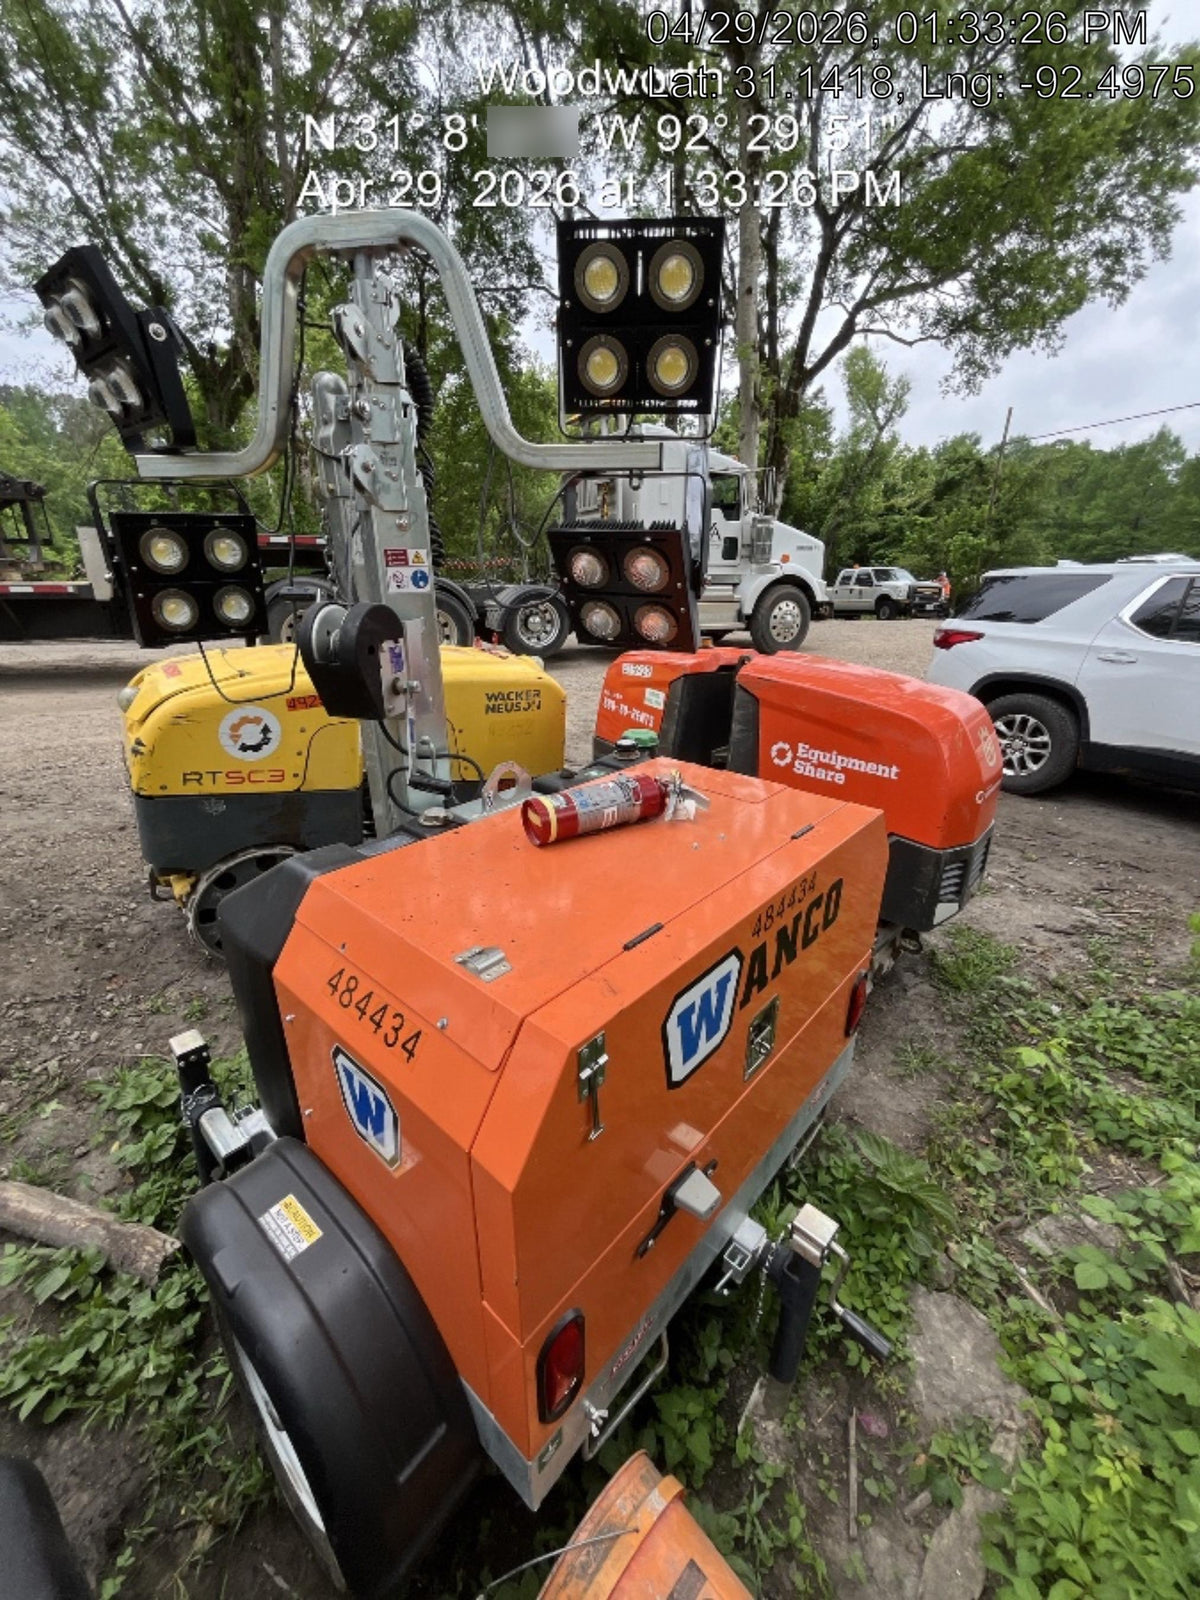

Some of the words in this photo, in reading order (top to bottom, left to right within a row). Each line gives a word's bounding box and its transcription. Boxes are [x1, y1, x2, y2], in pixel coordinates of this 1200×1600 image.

[182, 769, 286, 787] RTSC3
[793, 760, 845, 785] Share
[796, 742, 900, 780] Equipment
[751, 870, 818, 938] 484434
[327, 968, 422, 1063] 484434
[341, 1062, 387, 1148] W
